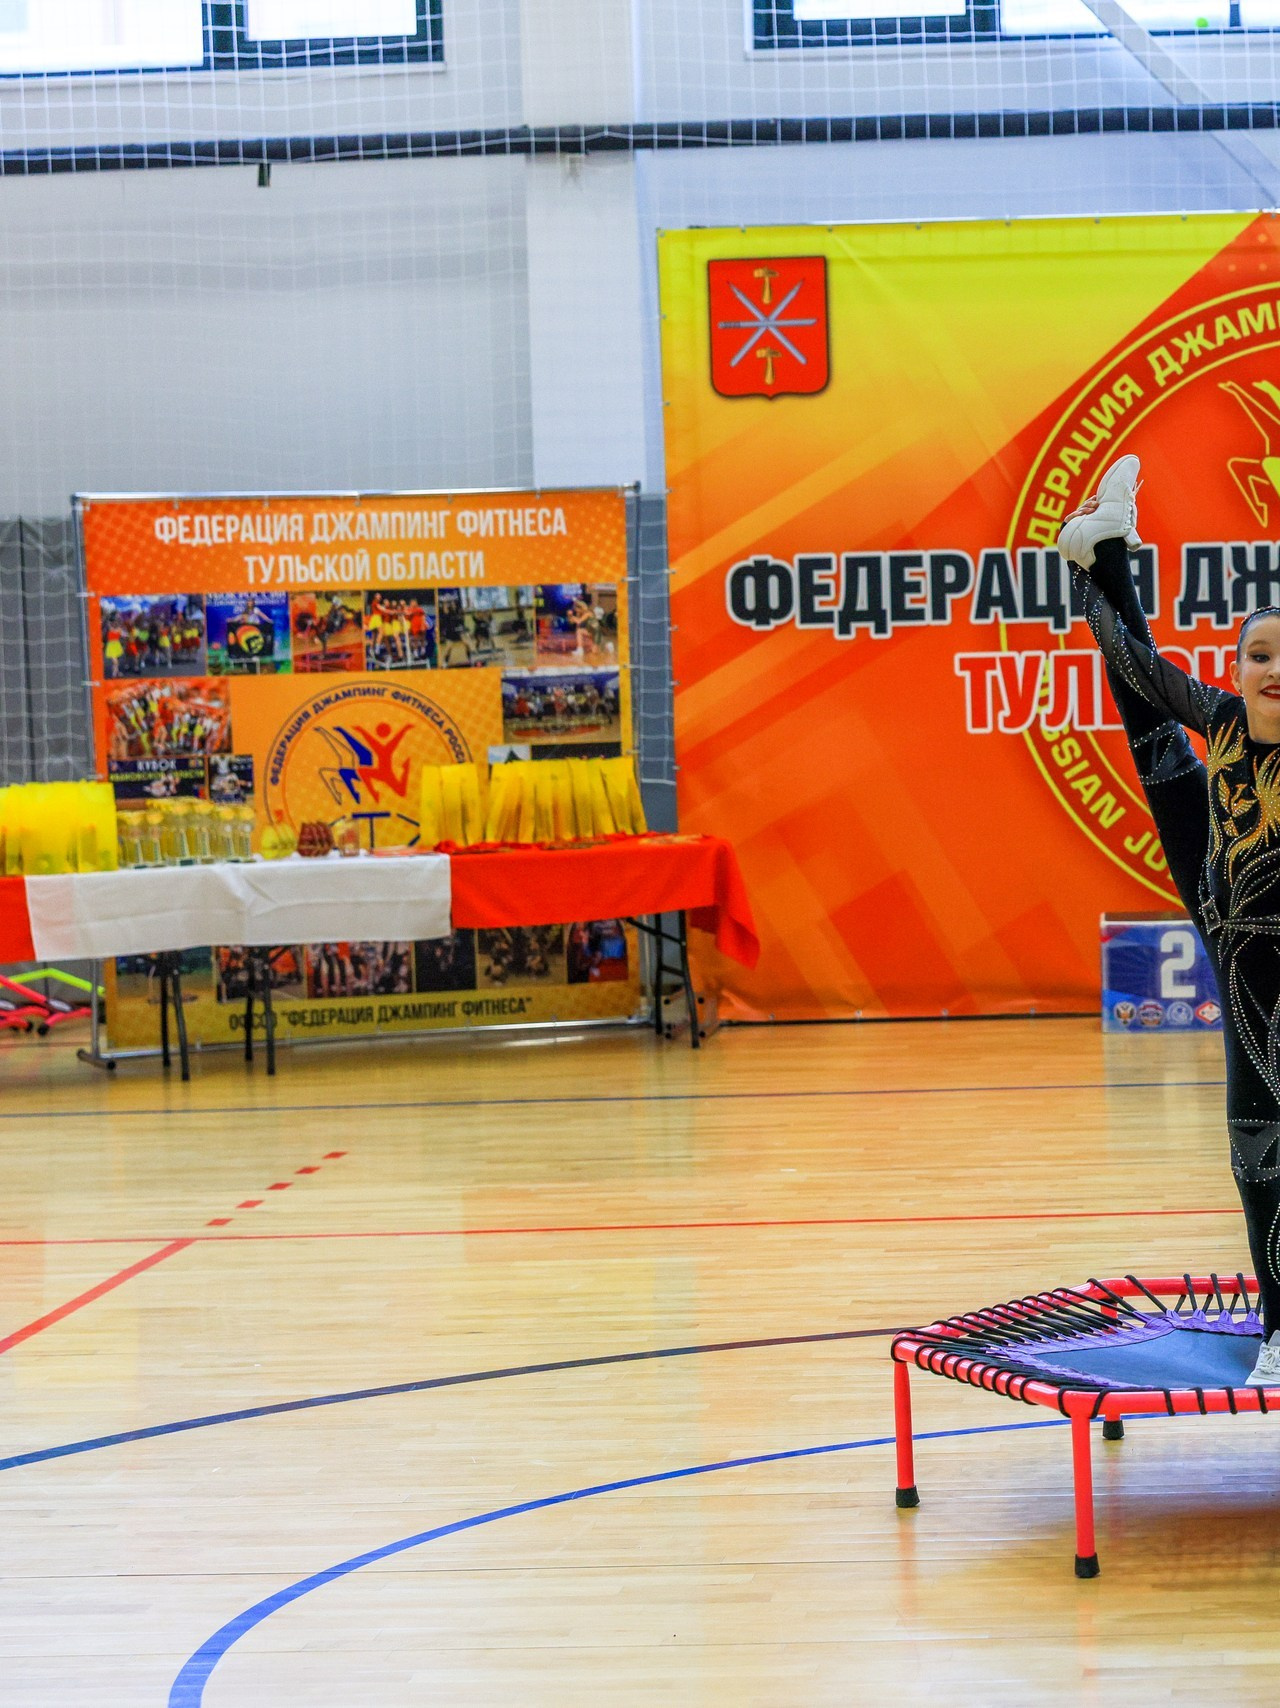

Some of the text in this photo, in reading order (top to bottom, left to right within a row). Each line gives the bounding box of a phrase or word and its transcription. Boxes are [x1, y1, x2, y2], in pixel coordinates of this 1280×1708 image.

[1026, 374, 1144, 547] ДЕРАЦИЯ
[154, 508, 567, 547] ФЕДЕРАЦИЯ ДЖАМПИНГ ФИТНЕСА
[244, 548, 485, 585] ТУЛЬСКОЙ ОБЛАСТИ
[727, 545, 1158, 639] ФЕДЕРАЦЯ
[270, 710, 312, 786] ФЕДЕРАЦИЯ
[313, 687, 388, 714] ДЖАМПИНГ
[391, 691, 445, 729] ФИТНЕСА
[1160, 931, 1196, 998] 2
[377, 1001, 458, 1024] ДЖАМПИНГ
